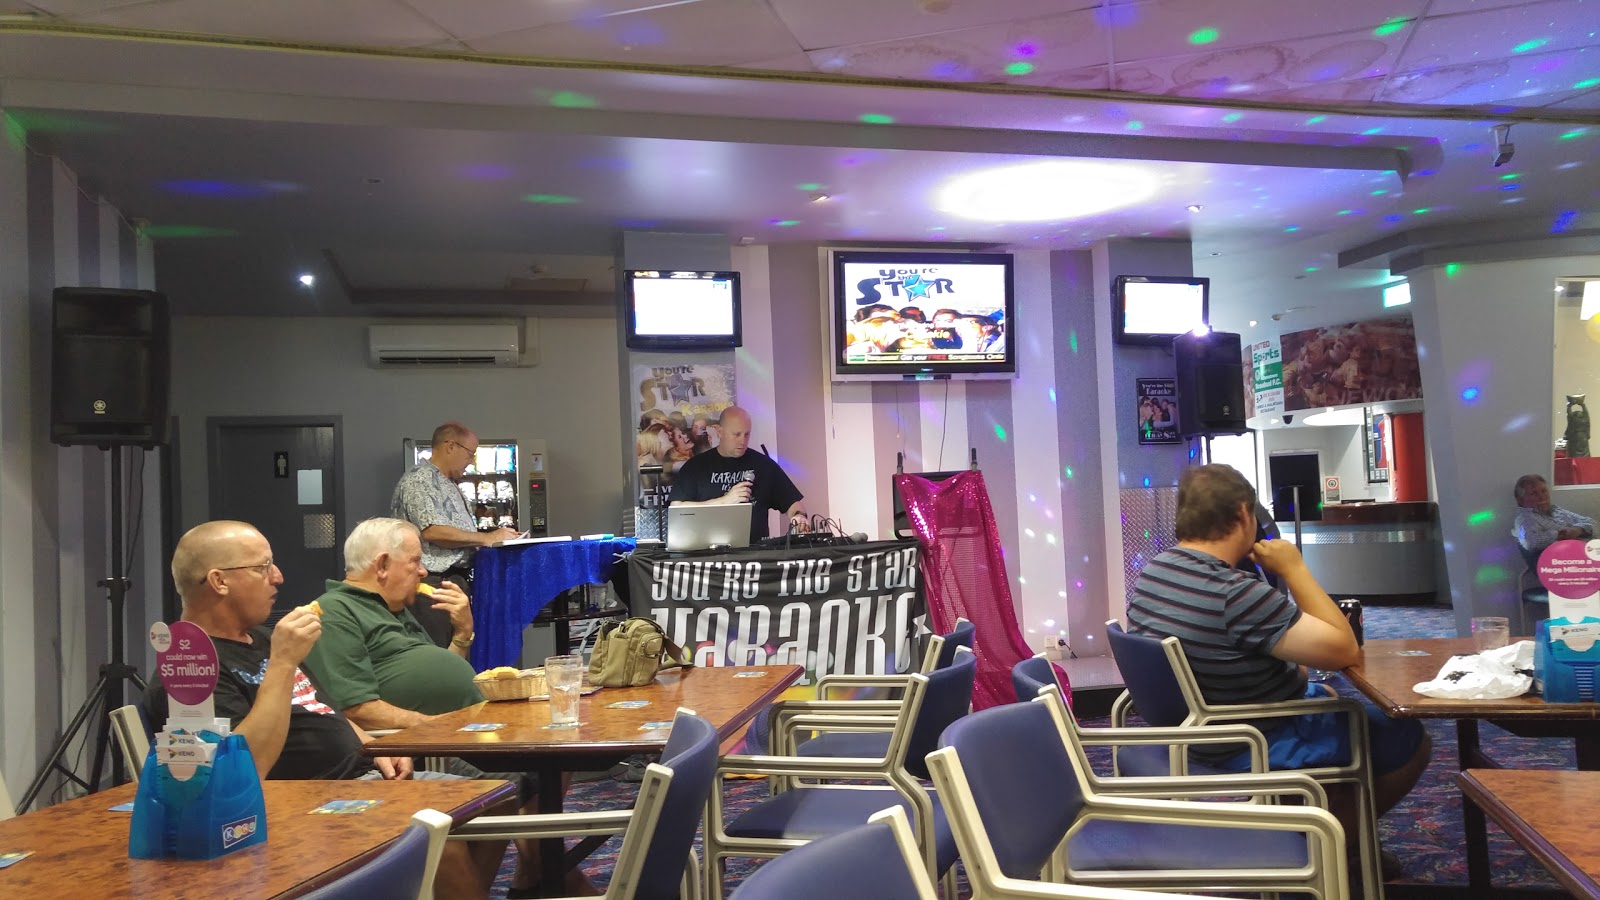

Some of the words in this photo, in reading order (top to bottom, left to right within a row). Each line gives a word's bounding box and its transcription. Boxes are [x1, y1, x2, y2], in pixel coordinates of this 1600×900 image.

[1253, 341, 1270, 351] UNITED
[1541, 566, 1562, 574] Mega
[179, 639, 191, 650] $2
[161, 663, 174, 677] $5
[177, 662, 216, 676] million!
